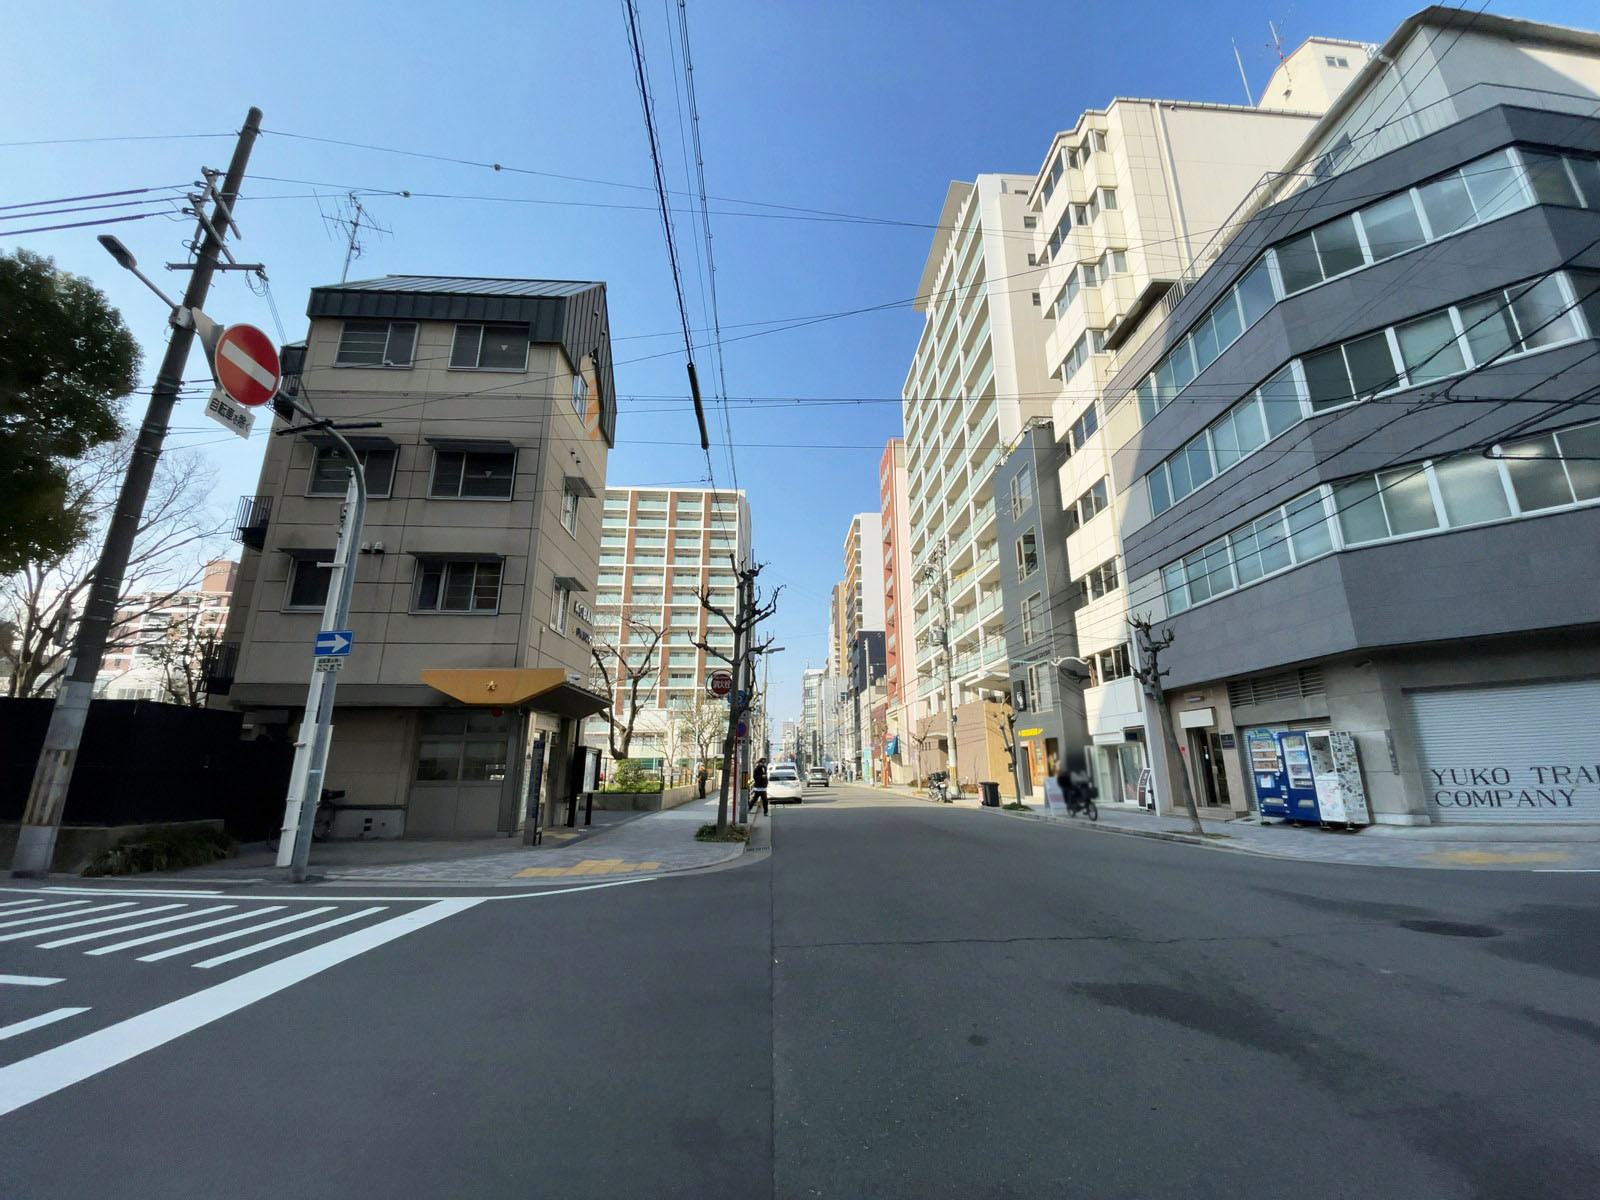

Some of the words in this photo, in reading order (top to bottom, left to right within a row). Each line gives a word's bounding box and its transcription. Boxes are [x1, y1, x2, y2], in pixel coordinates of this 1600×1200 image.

[209, 398, 250, 432] 自転車を除く
[1431, 767, 1511, 786] YUKO
[1434, 788, 1576, 808] COMPANY
